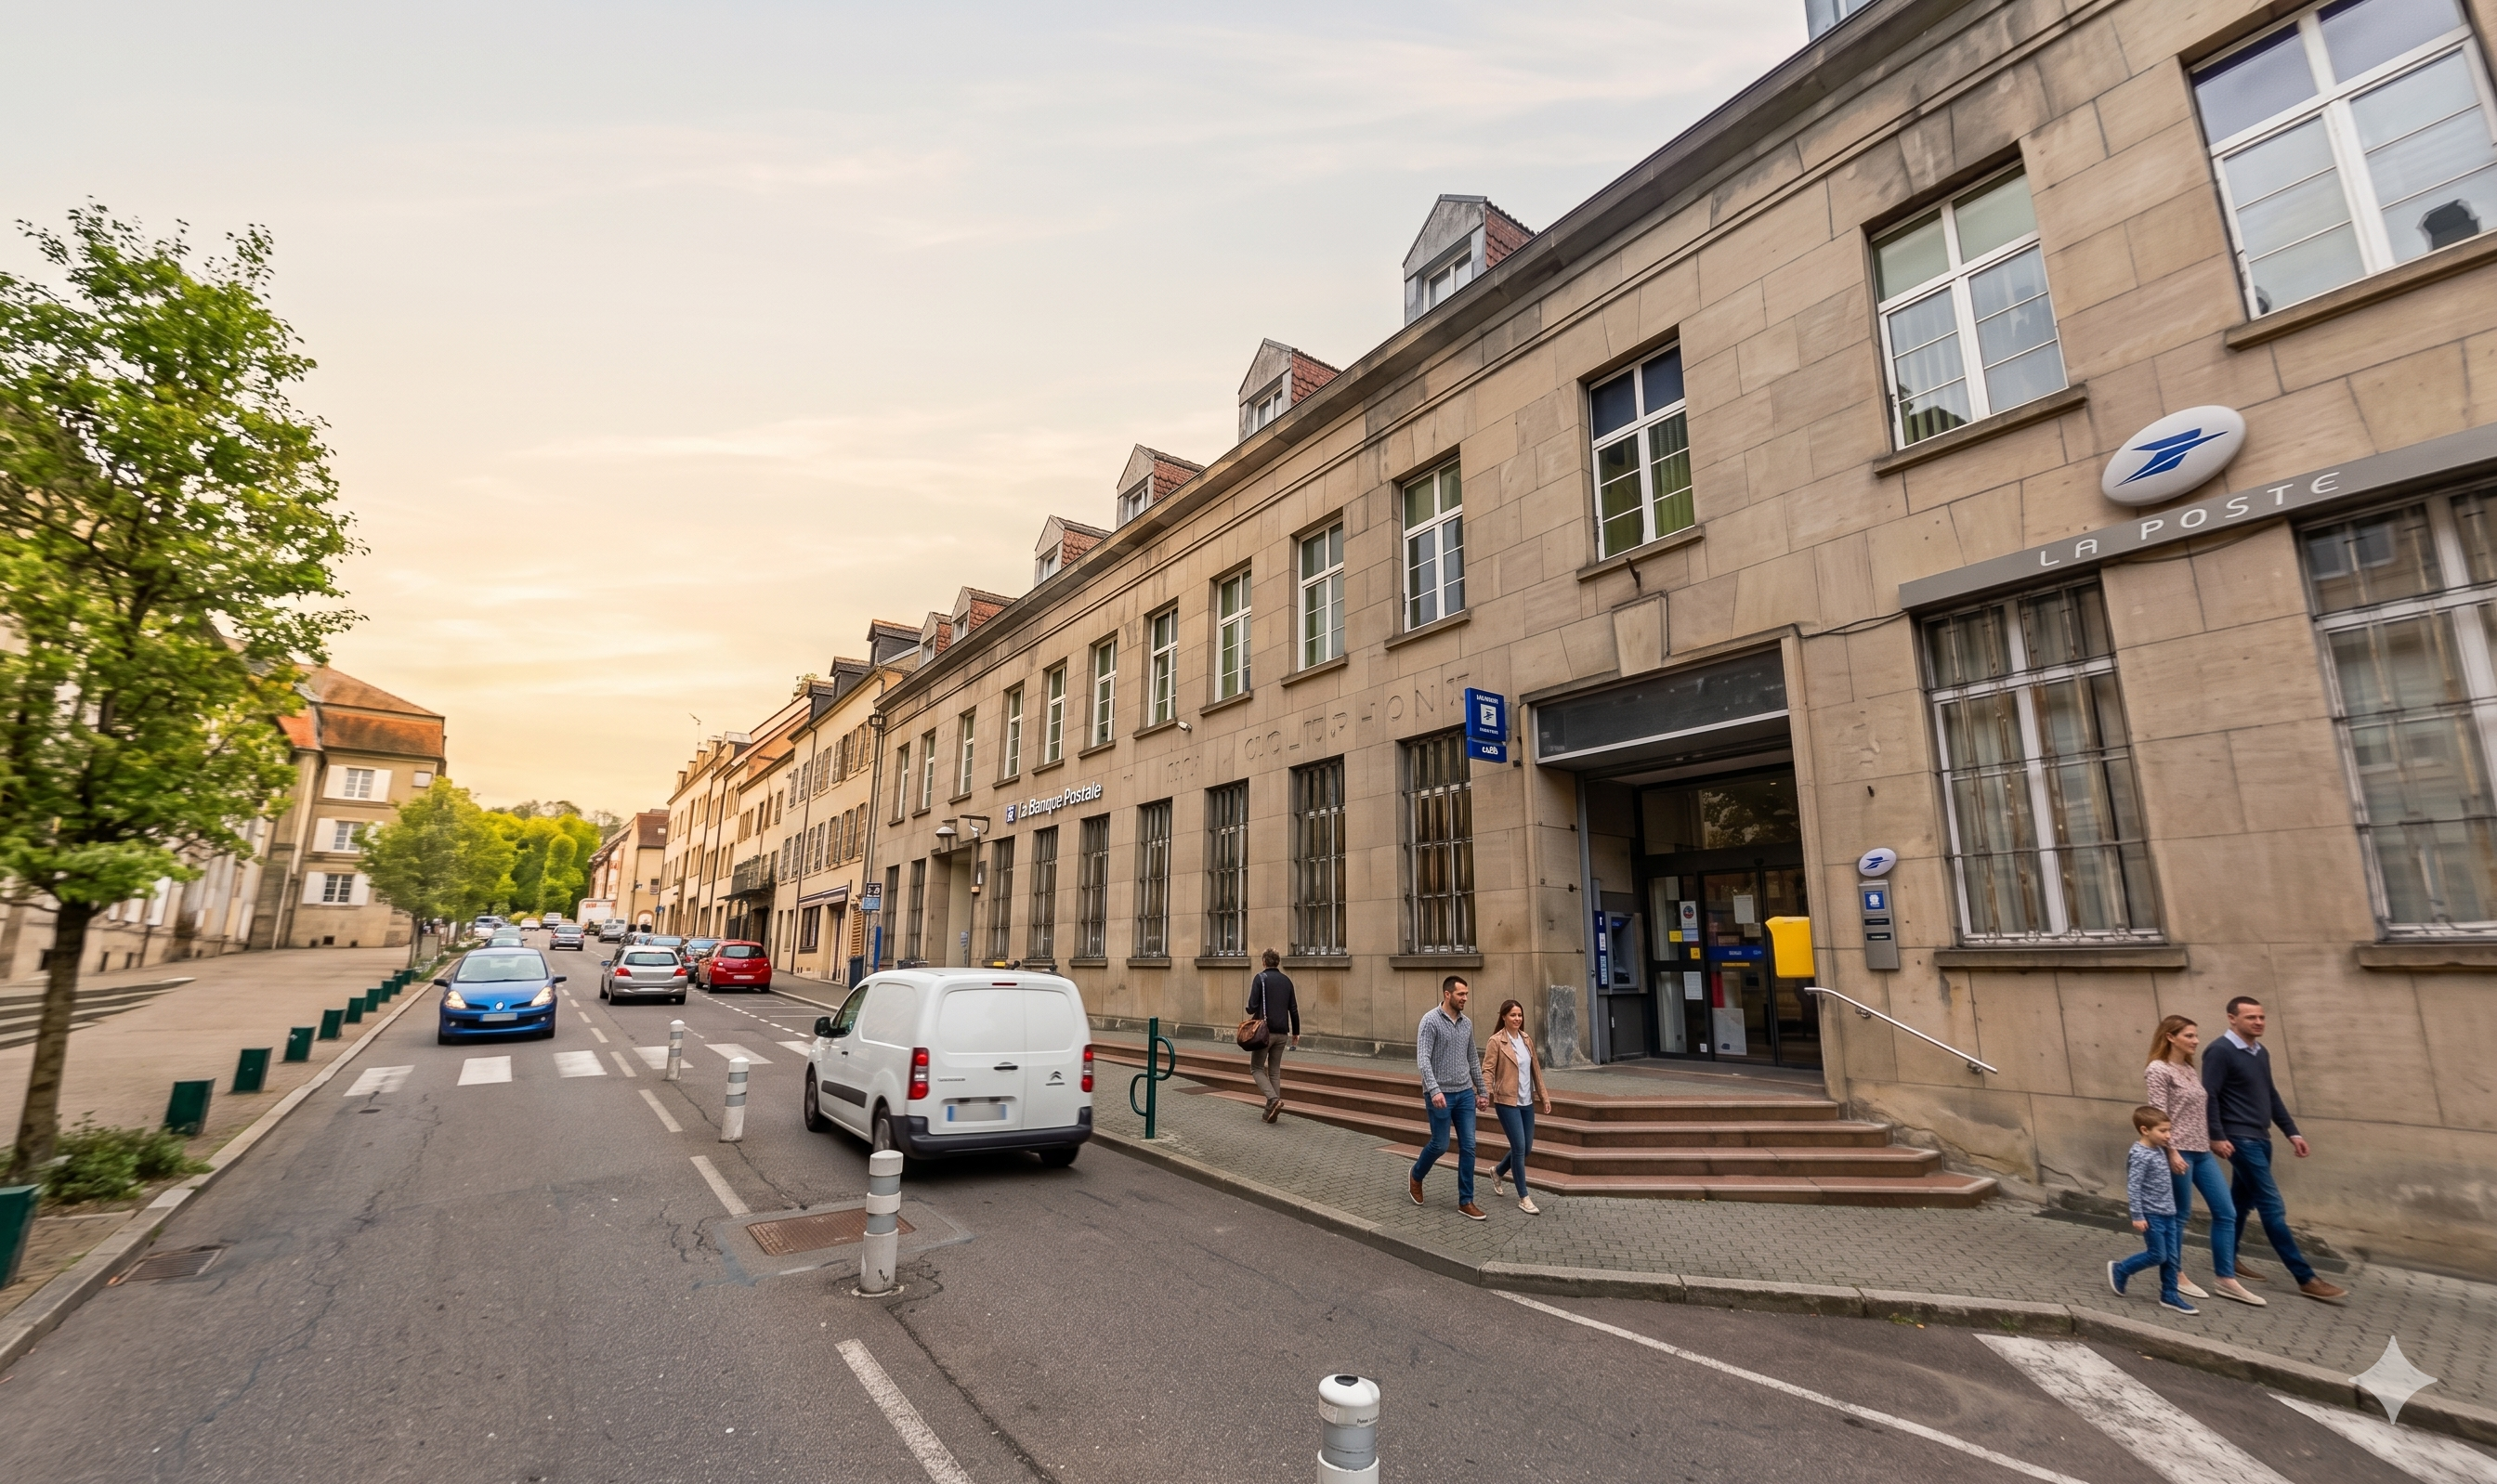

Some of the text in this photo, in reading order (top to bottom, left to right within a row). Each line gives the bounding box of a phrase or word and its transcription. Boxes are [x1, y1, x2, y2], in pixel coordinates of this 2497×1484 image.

[2039, 471, 2341, 567] LA POSTE
[1028, 798, 1062, 814] Banque
[1063, 781, 1101, 806] Postale
